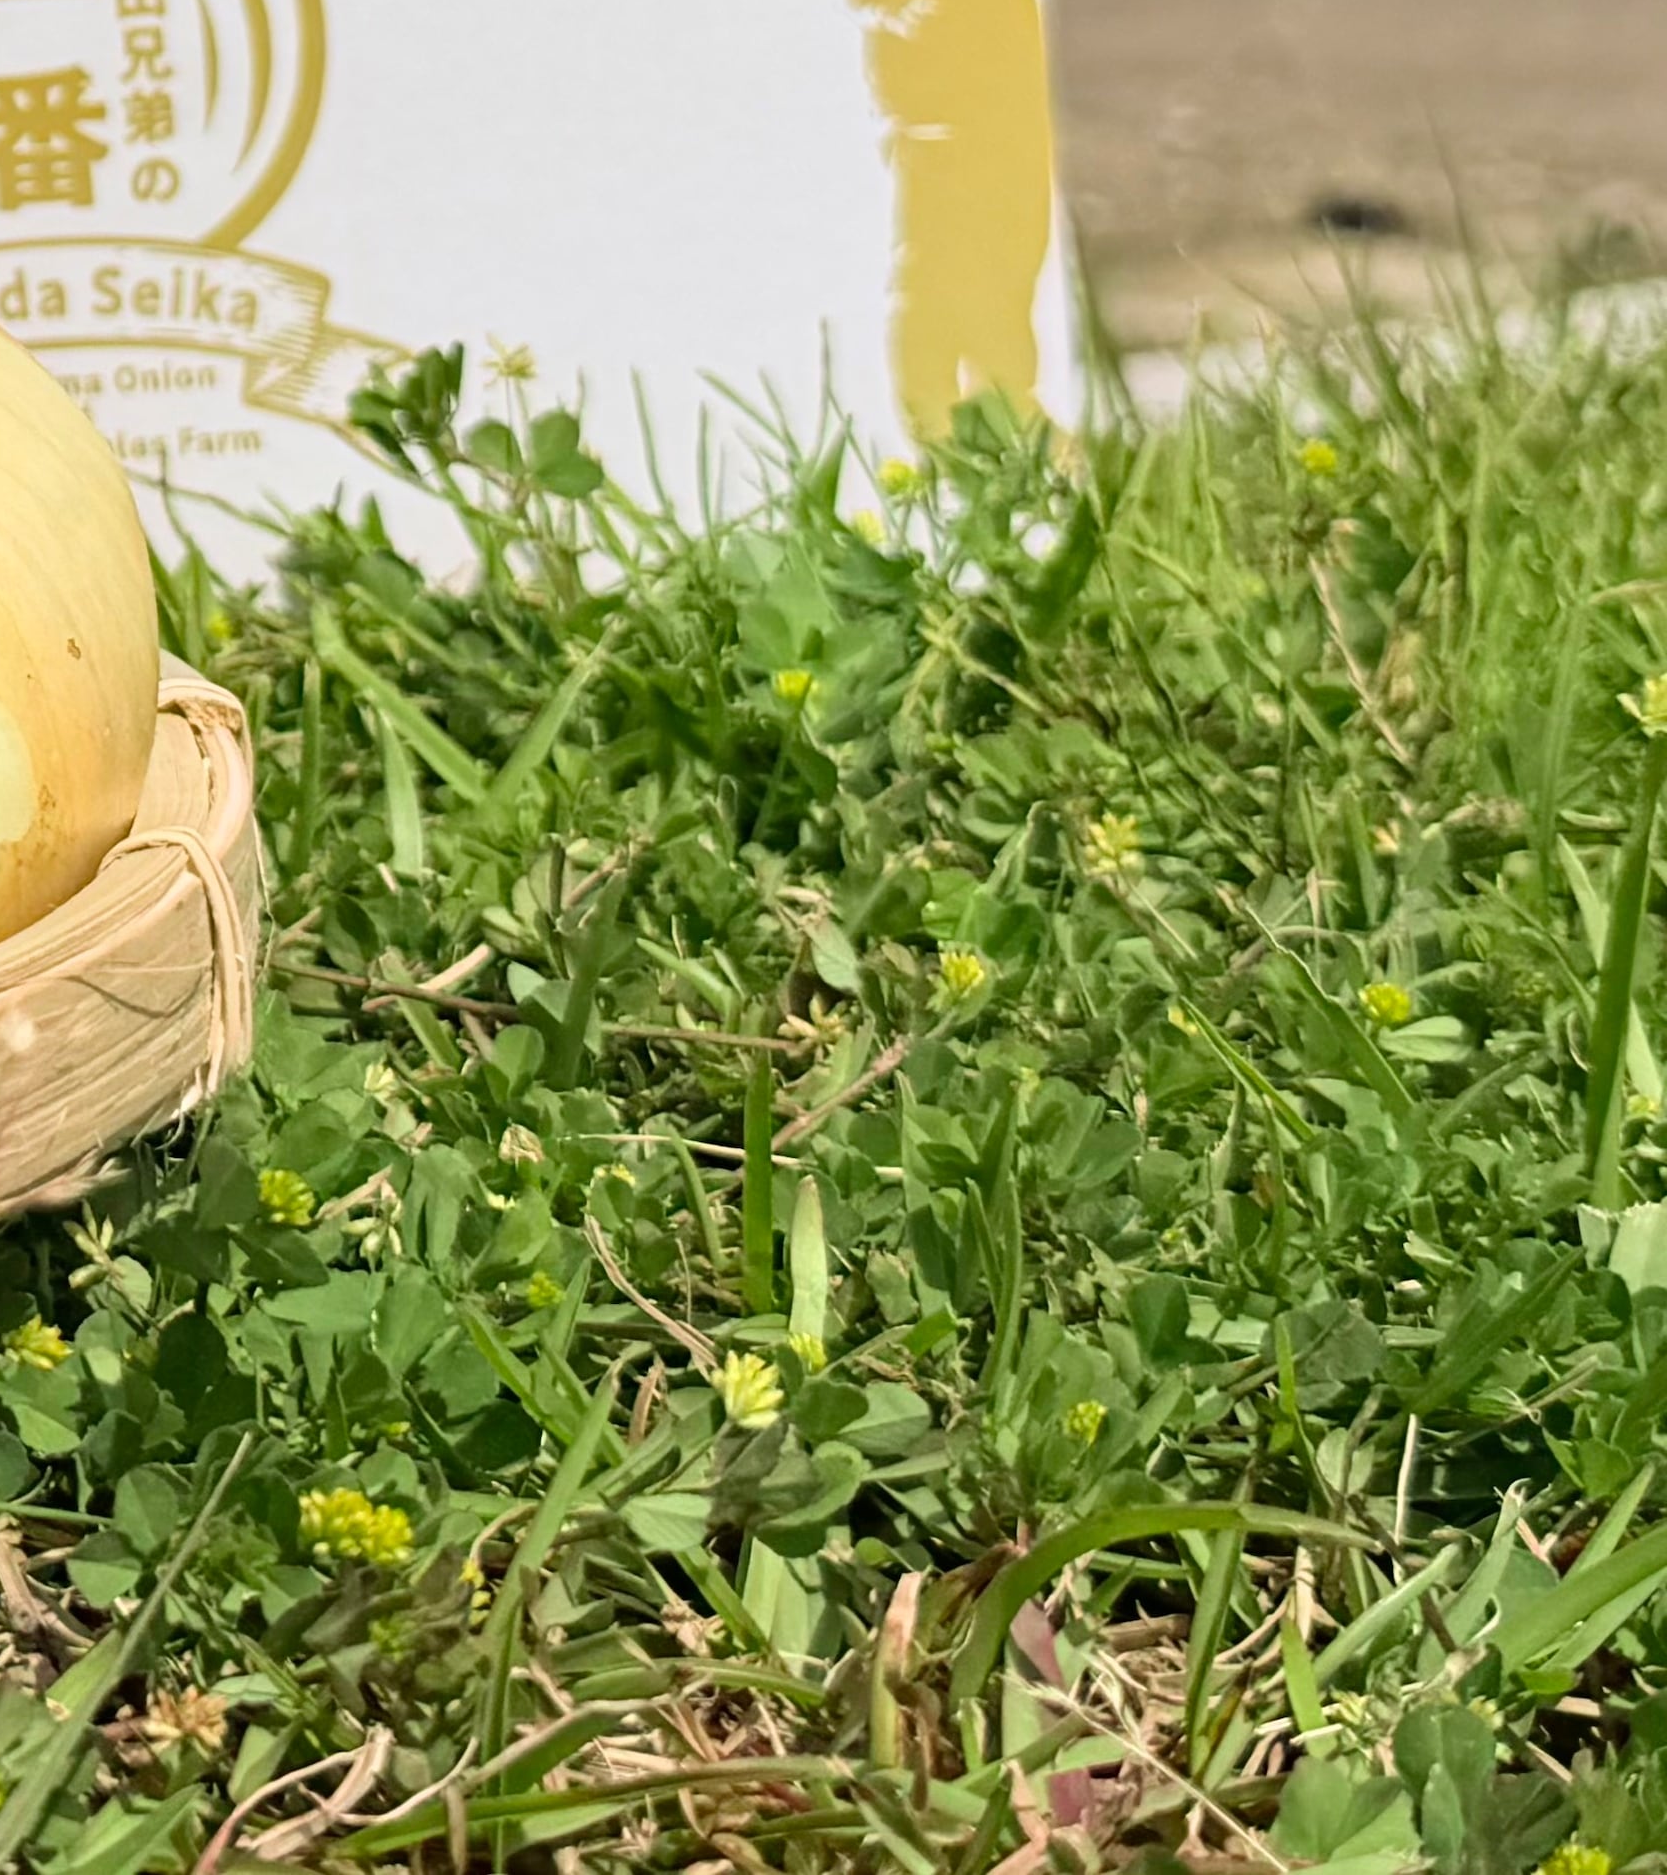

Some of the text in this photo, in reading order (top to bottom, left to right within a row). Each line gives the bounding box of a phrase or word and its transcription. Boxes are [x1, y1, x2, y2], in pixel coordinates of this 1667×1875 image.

[90, 264, 261, 331] Seika
[113, 357, 218, 394] Onion
[176, 426, 262, 456] Farm
